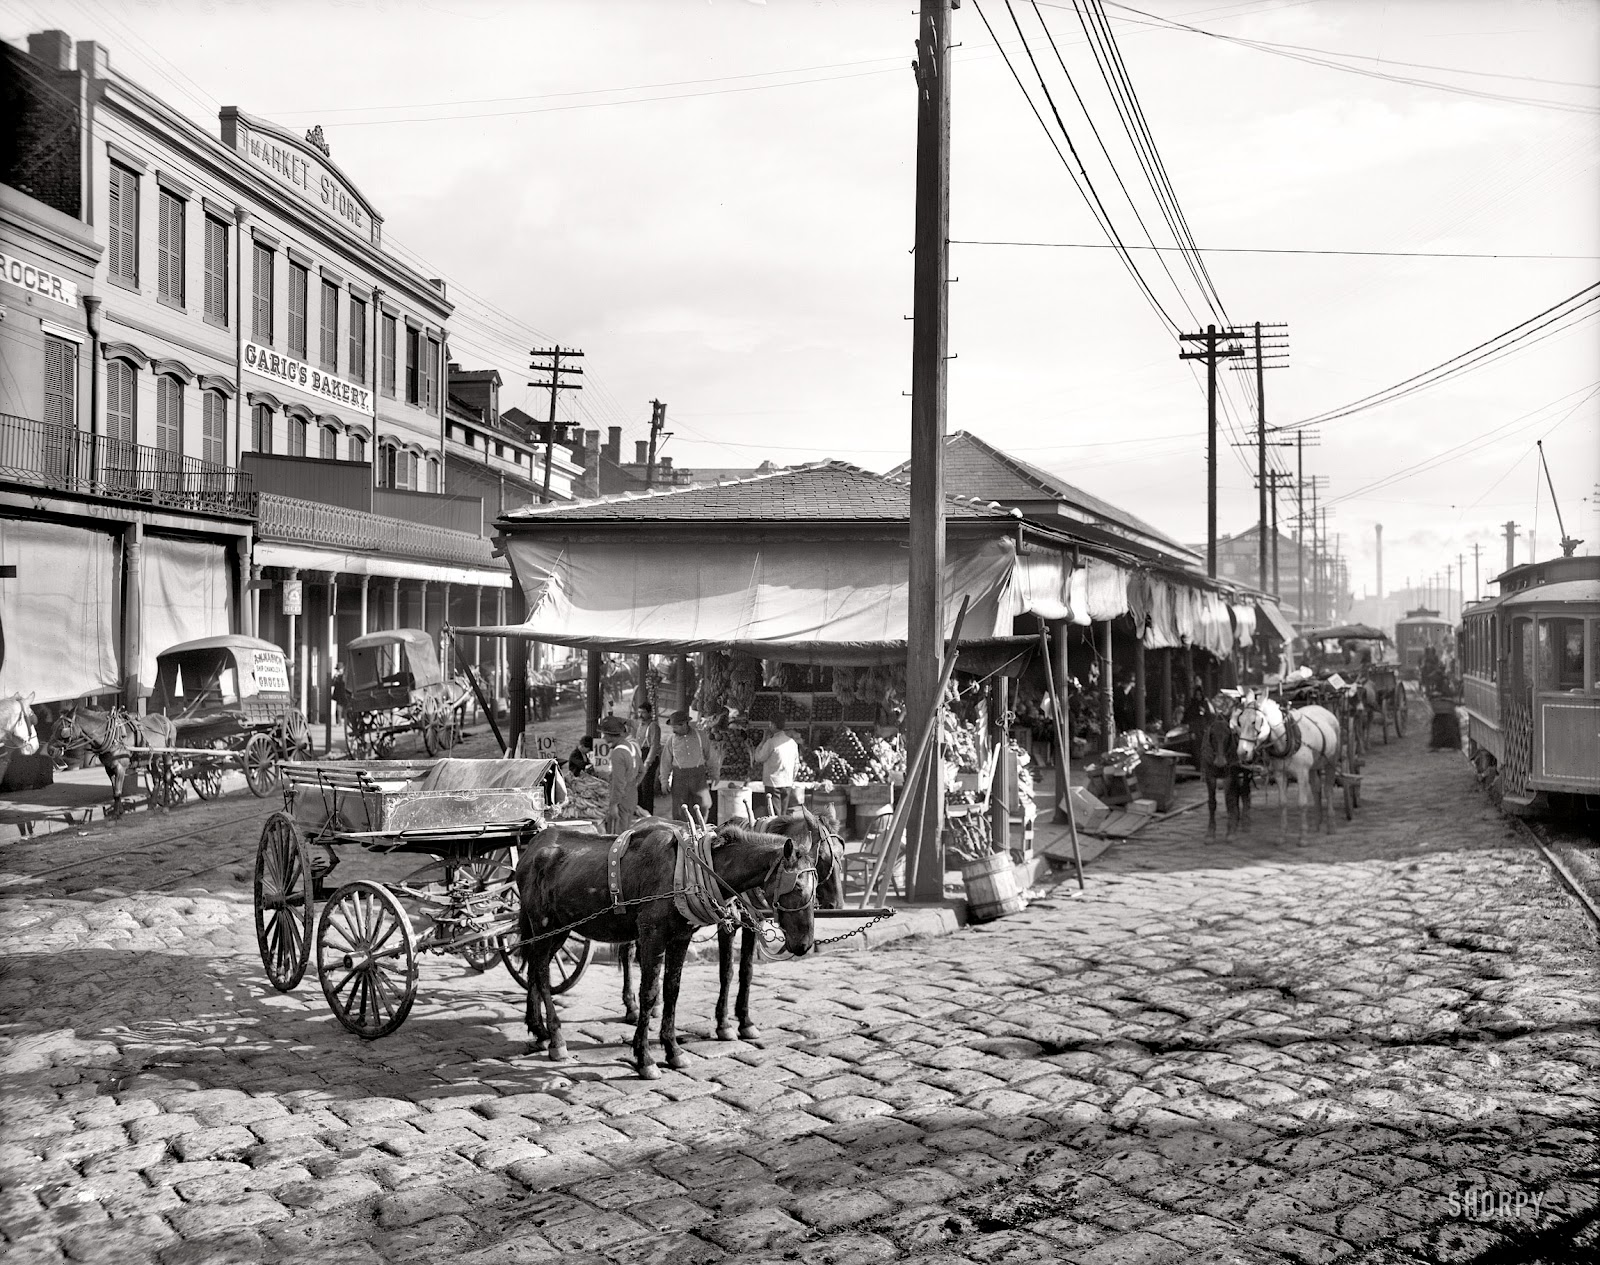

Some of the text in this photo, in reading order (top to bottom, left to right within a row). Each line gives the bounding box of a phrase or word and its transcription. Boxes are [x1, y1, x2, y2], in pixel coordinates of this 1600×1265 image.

[250, 138, 362, 229] MARKET STORE
[244, 343, 370, 411] GARIC'S BAKERY.
[258, 676, 286, 689] GROCER
